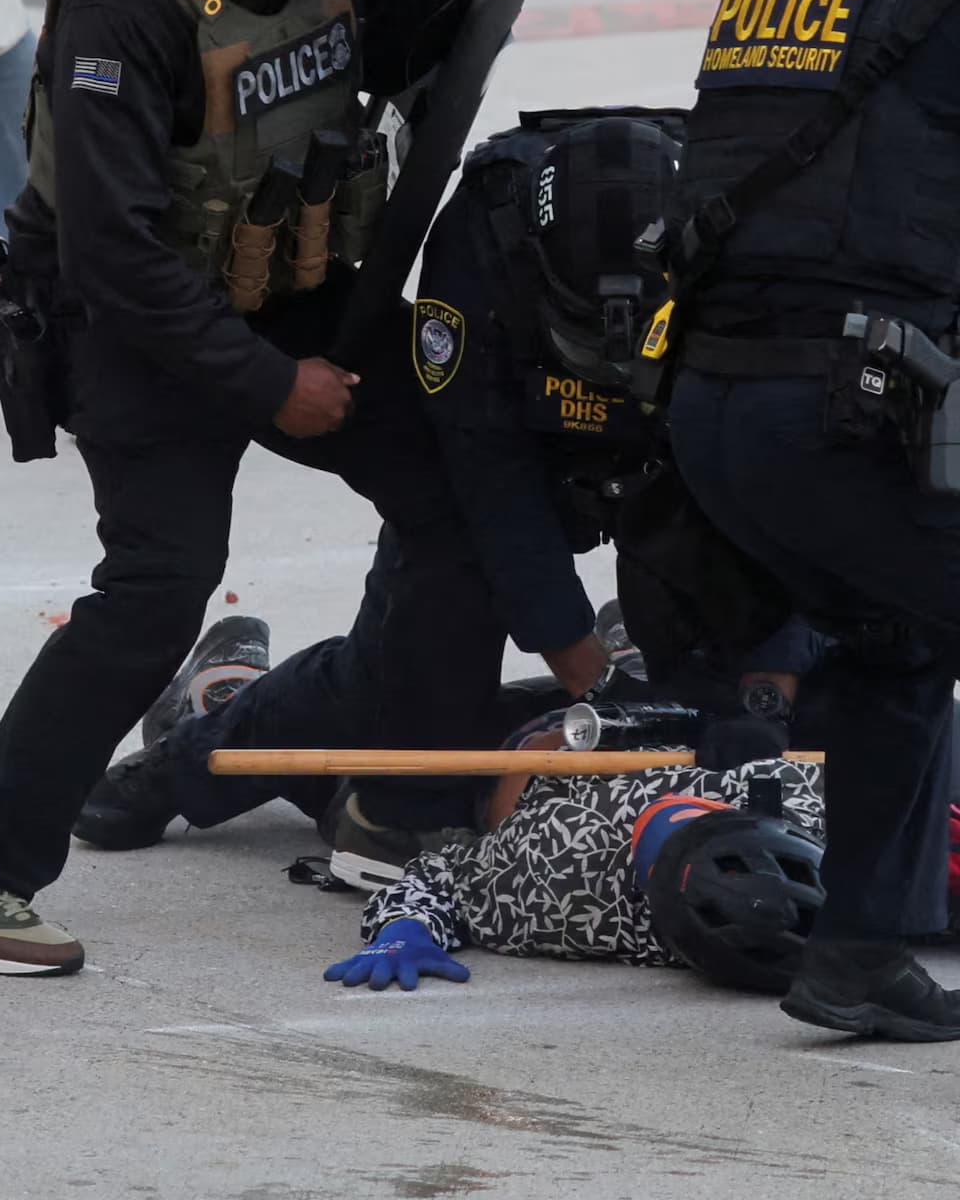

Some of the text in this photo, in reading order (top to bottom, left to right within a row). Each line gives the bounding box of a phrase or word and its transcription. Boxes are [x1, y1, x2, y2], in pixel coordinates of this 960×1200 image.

[702, 45, 842, 73] HOMELAND SECURITY
[237, 34, 333, 116] POLICE
[419, 305, 461, 329] POLICE
[545, 376, 625, 403] POL
[864, 373, 882, 388] TQ
[561, 400, 608, 422] DHS
